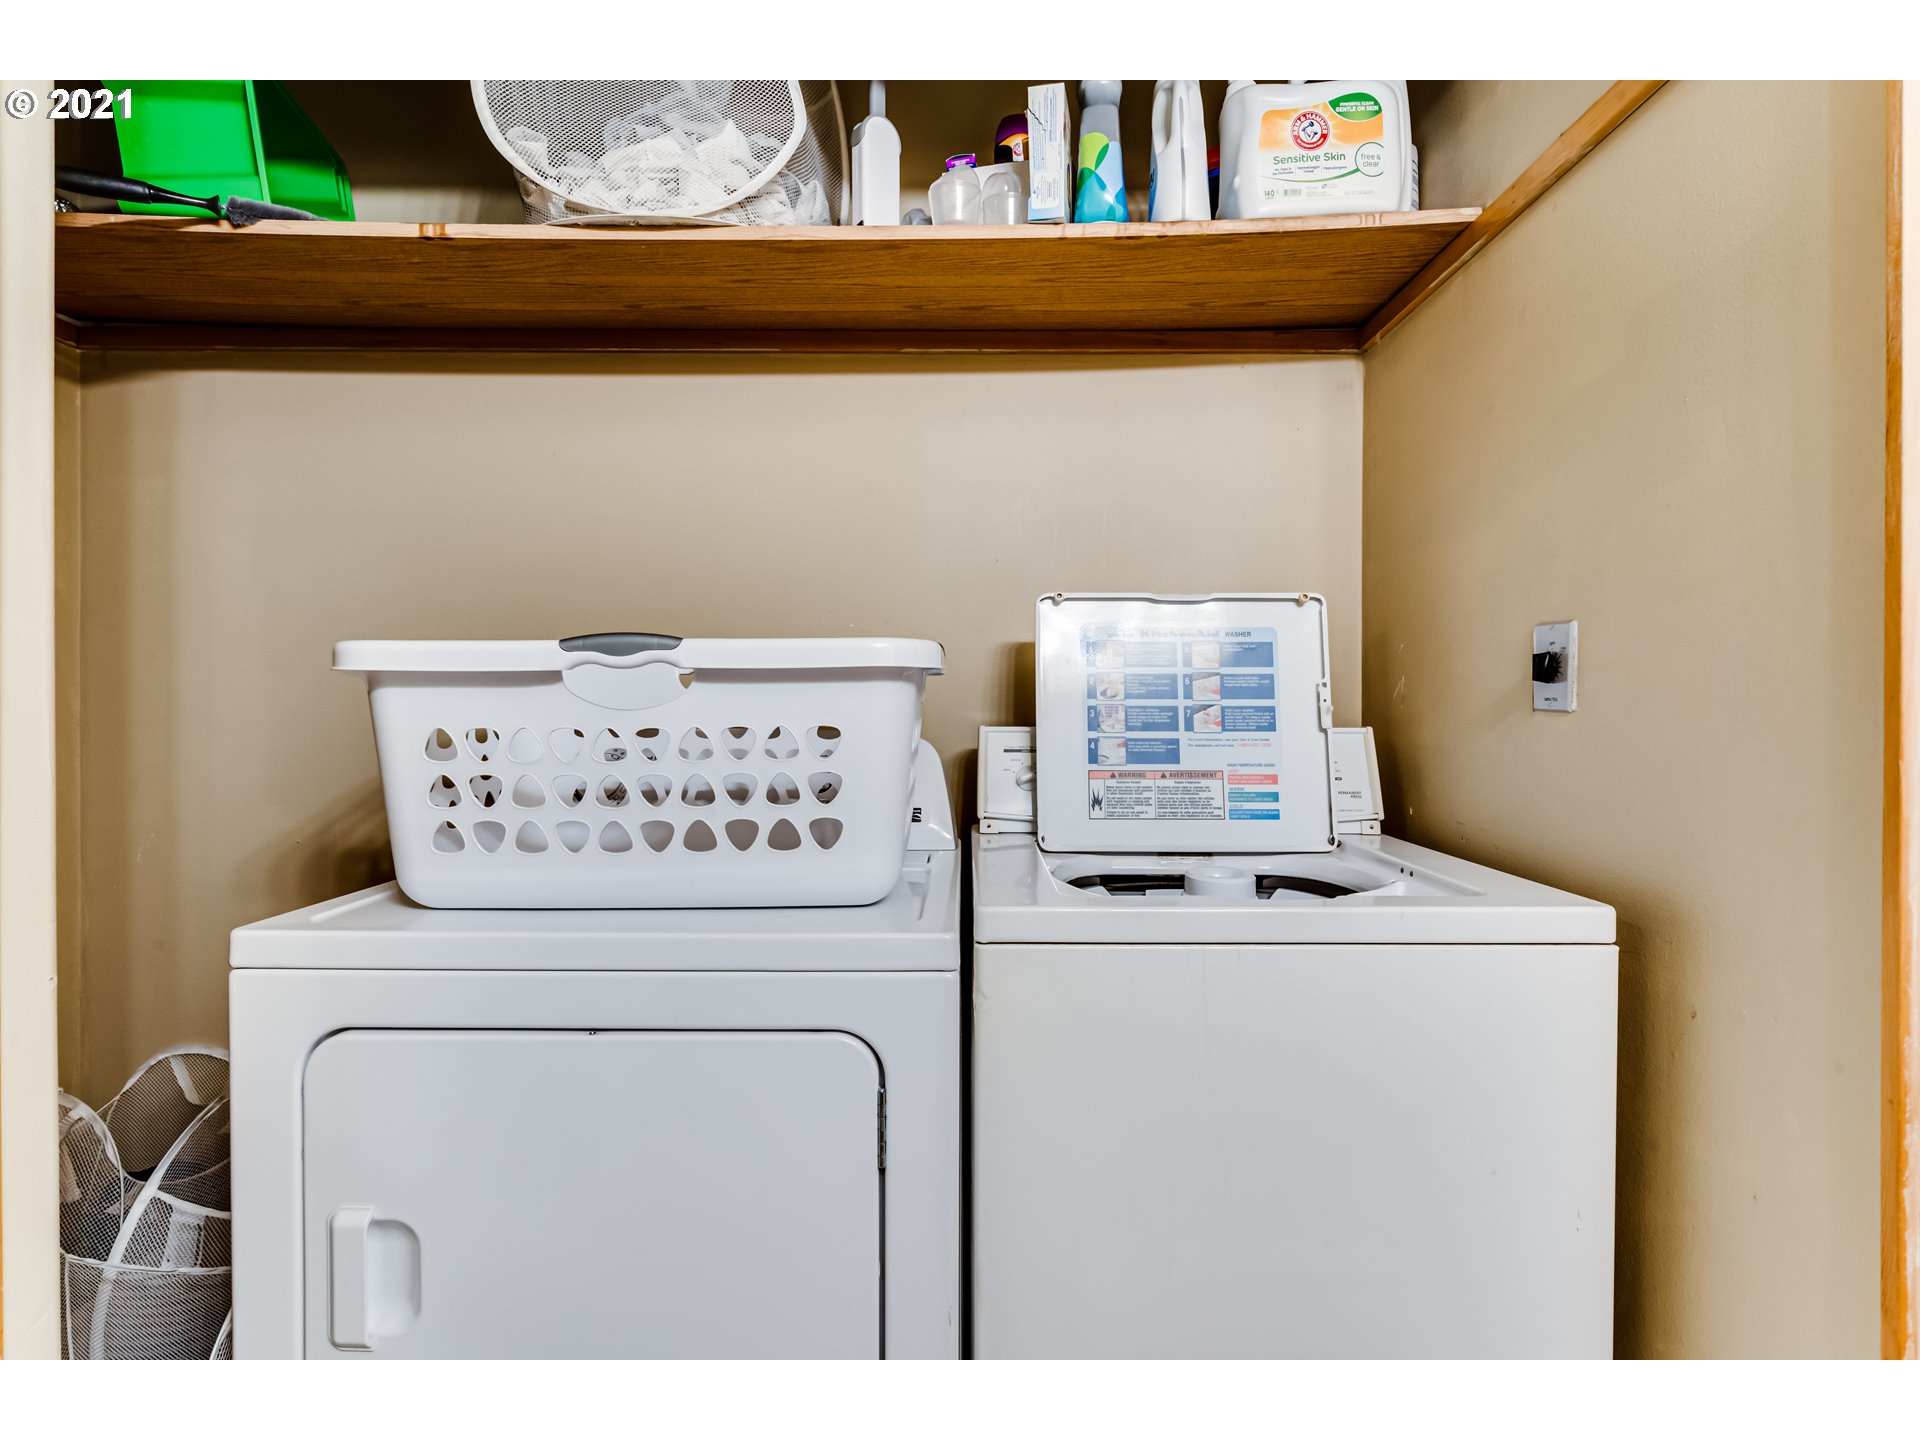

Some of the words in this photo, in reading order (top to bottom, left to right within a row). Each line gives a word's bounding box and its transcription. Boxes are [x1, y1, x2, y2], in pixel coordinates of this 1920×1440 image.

[1306, 113, 1328, 135] HAMMER
[1273, 153, 1320, 165] Sensitive
[1323, 152, 1346, 162] Skin
[1361, 153, 1375, 161] free
[1362, 160, 1380, 168] clear
[1264, 189, 1275, 197] 140
[1184, 677, 1190, 686] 6
[1089, 709, 1095, 717] 3
[1185, 709, 1191, 718] 7
[1089, 742, 1095, 750] 4
